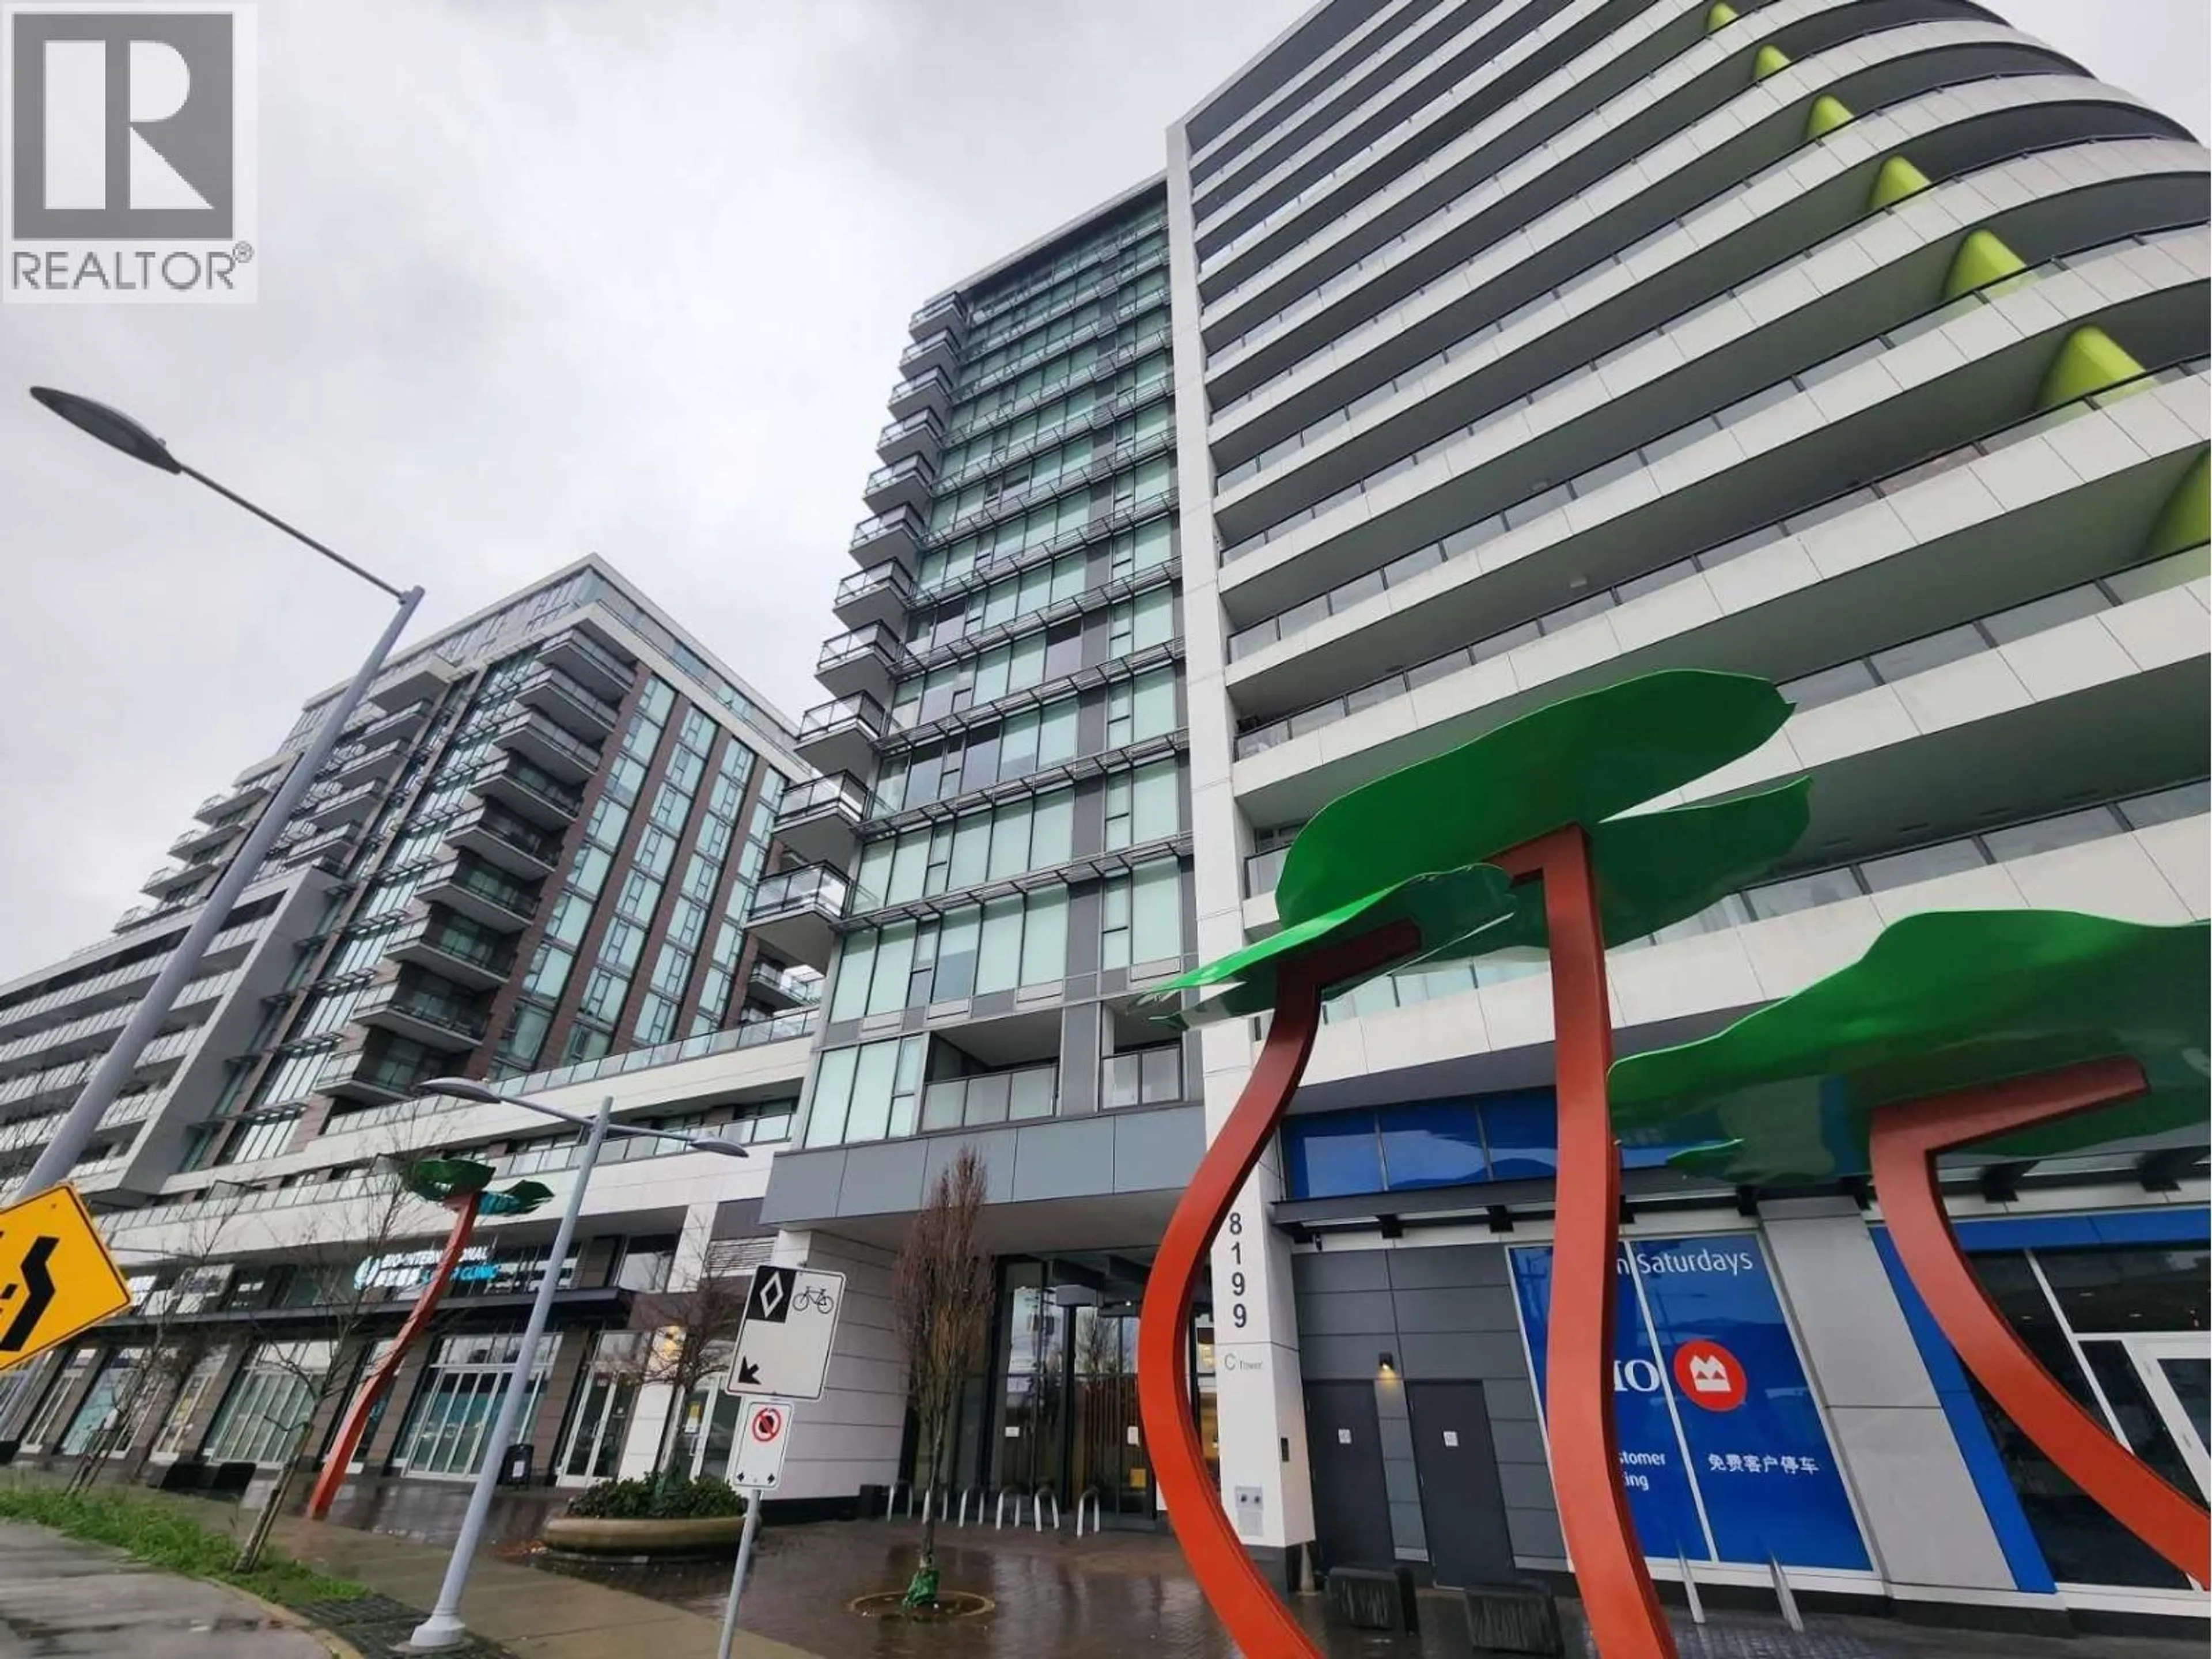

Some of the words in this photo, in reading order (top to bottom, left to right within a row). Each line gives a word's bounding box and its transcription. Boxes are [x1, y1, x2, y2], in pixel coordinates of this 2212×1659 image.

[1230, 1212, 1247, 1328] 8199
[1637, 1248, 1753, 1276] Saturdays
[1225, 1353, 1236, 1370] C
[1708, 1453, 1819, 1475] 免费客户停车
